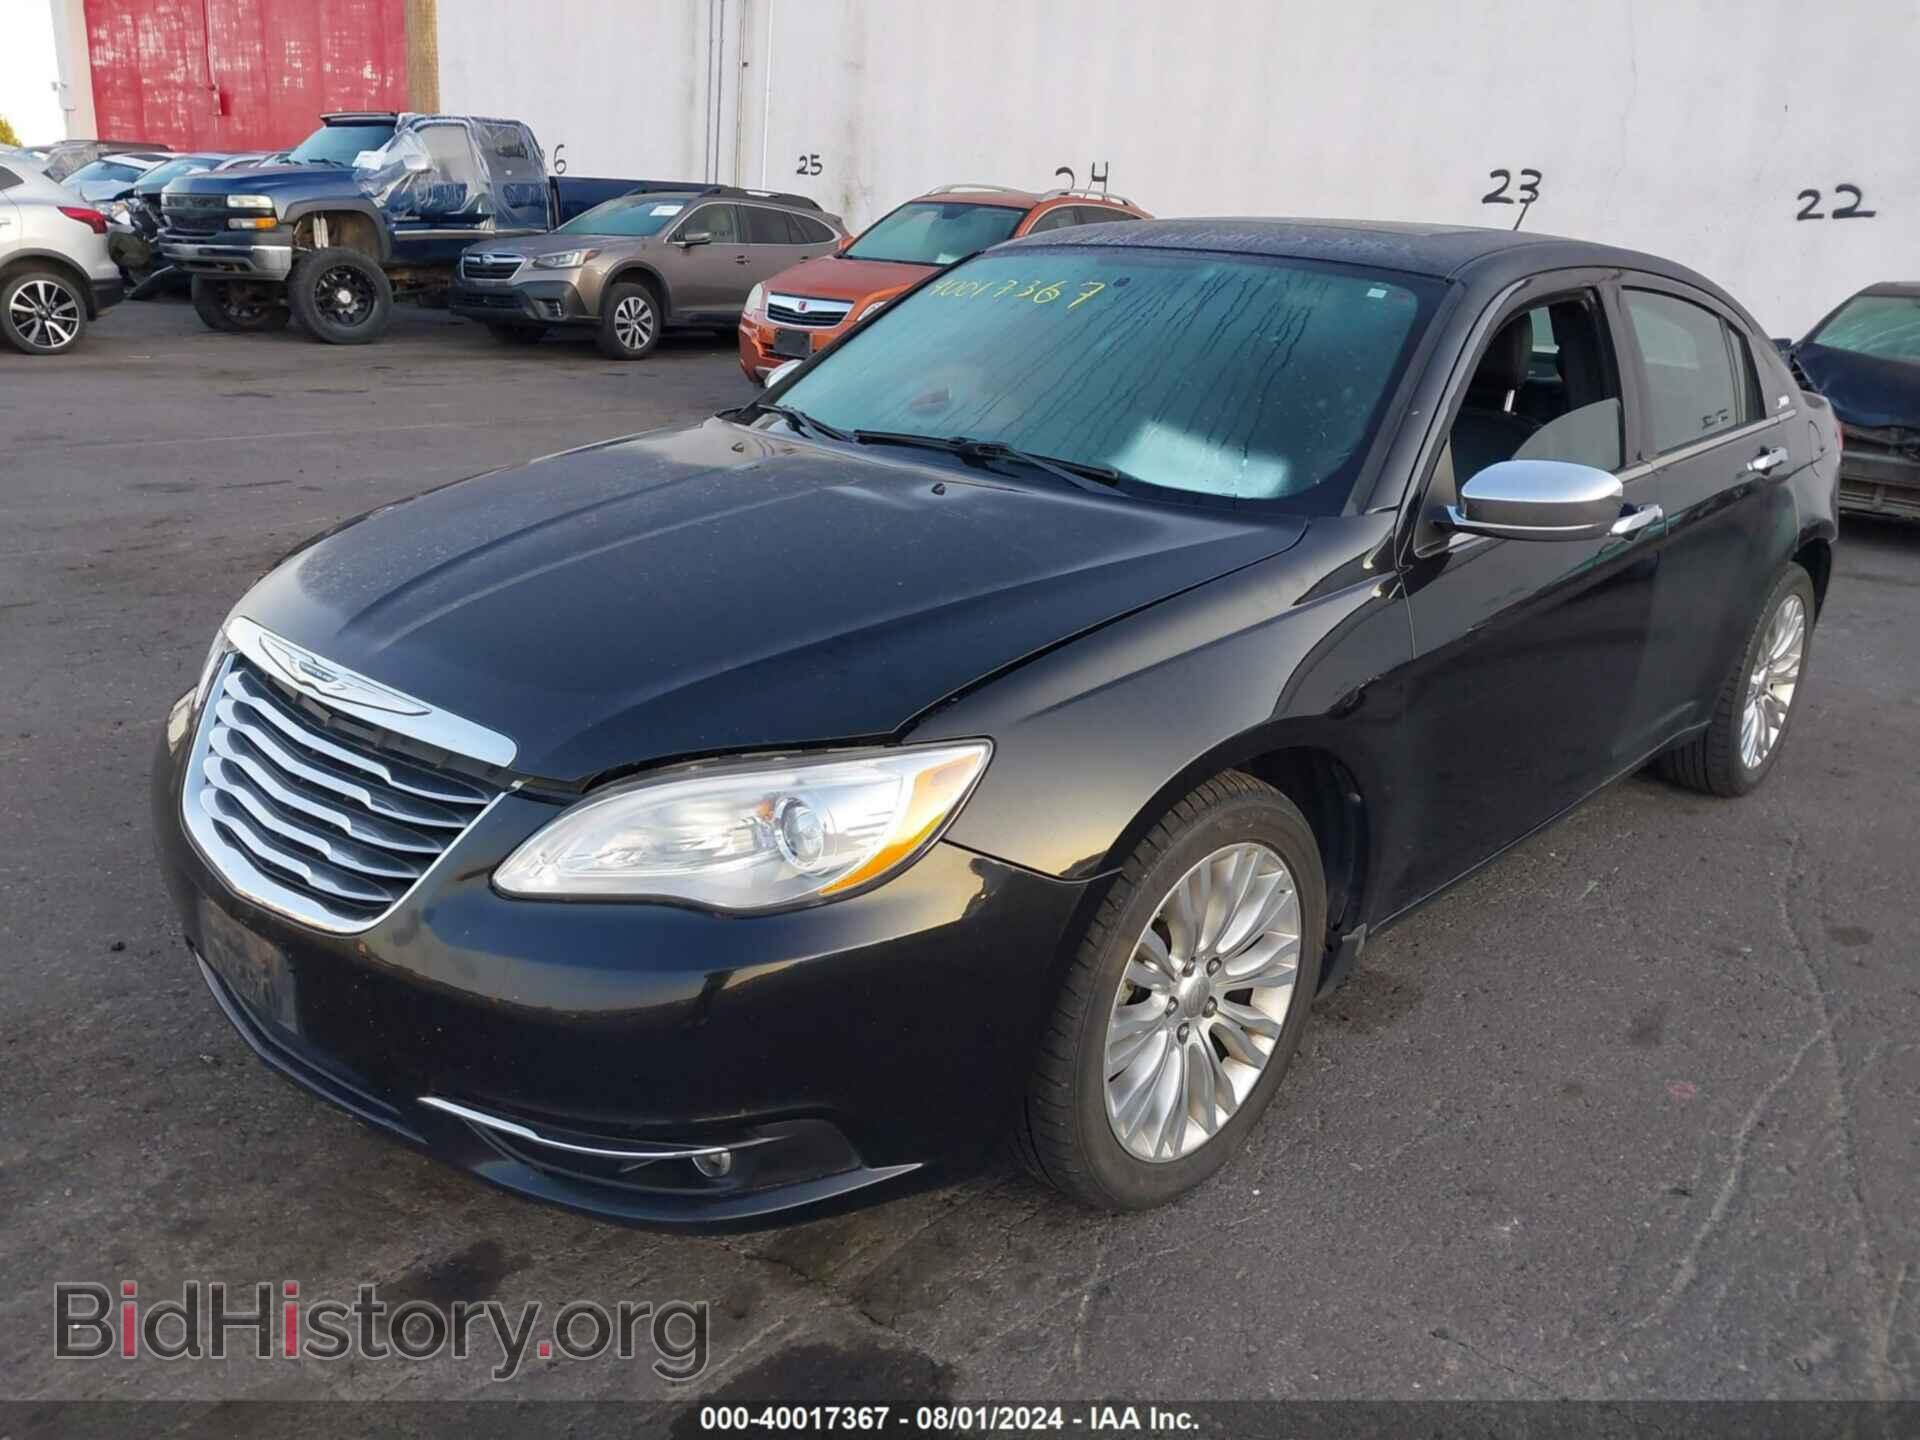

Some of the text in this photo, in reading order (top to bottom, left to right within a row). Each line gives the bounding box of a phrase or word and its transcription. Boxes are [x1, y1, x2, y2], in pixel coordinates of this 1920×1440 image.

[796, 154, 823, 175] 25
[1482, 169, 1542, 204] 23
[1797, 184, 1876, 221] 22
